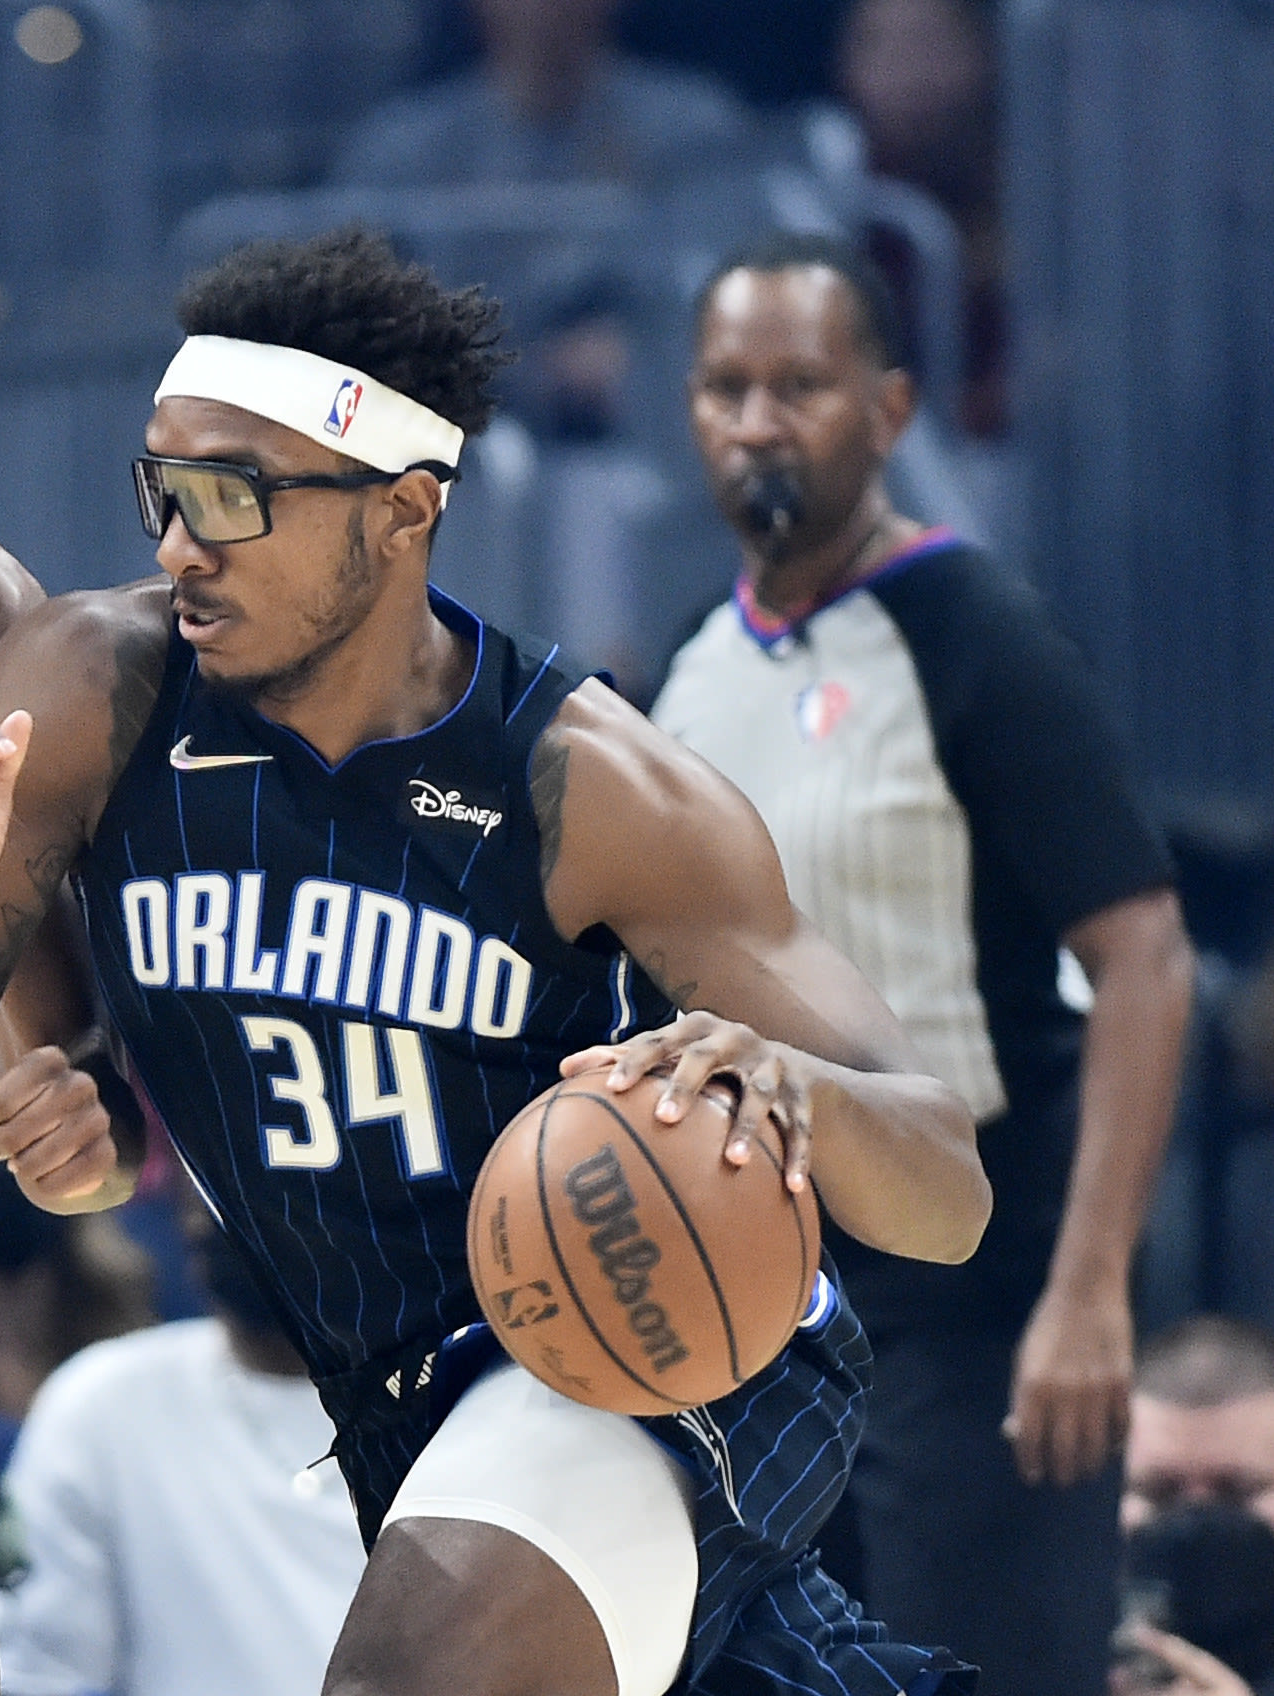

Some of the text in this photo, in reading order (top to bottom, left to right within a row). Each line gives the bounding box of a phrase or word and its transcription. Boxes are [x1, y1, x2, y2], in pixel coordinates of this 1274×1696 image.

[408, 779, 503, 837] Disney
[122, 870, 533, 1039] ORLANDO
[238, 1013, 446, 1180] 34
[564, 1142, 689, 1374] Wilson
